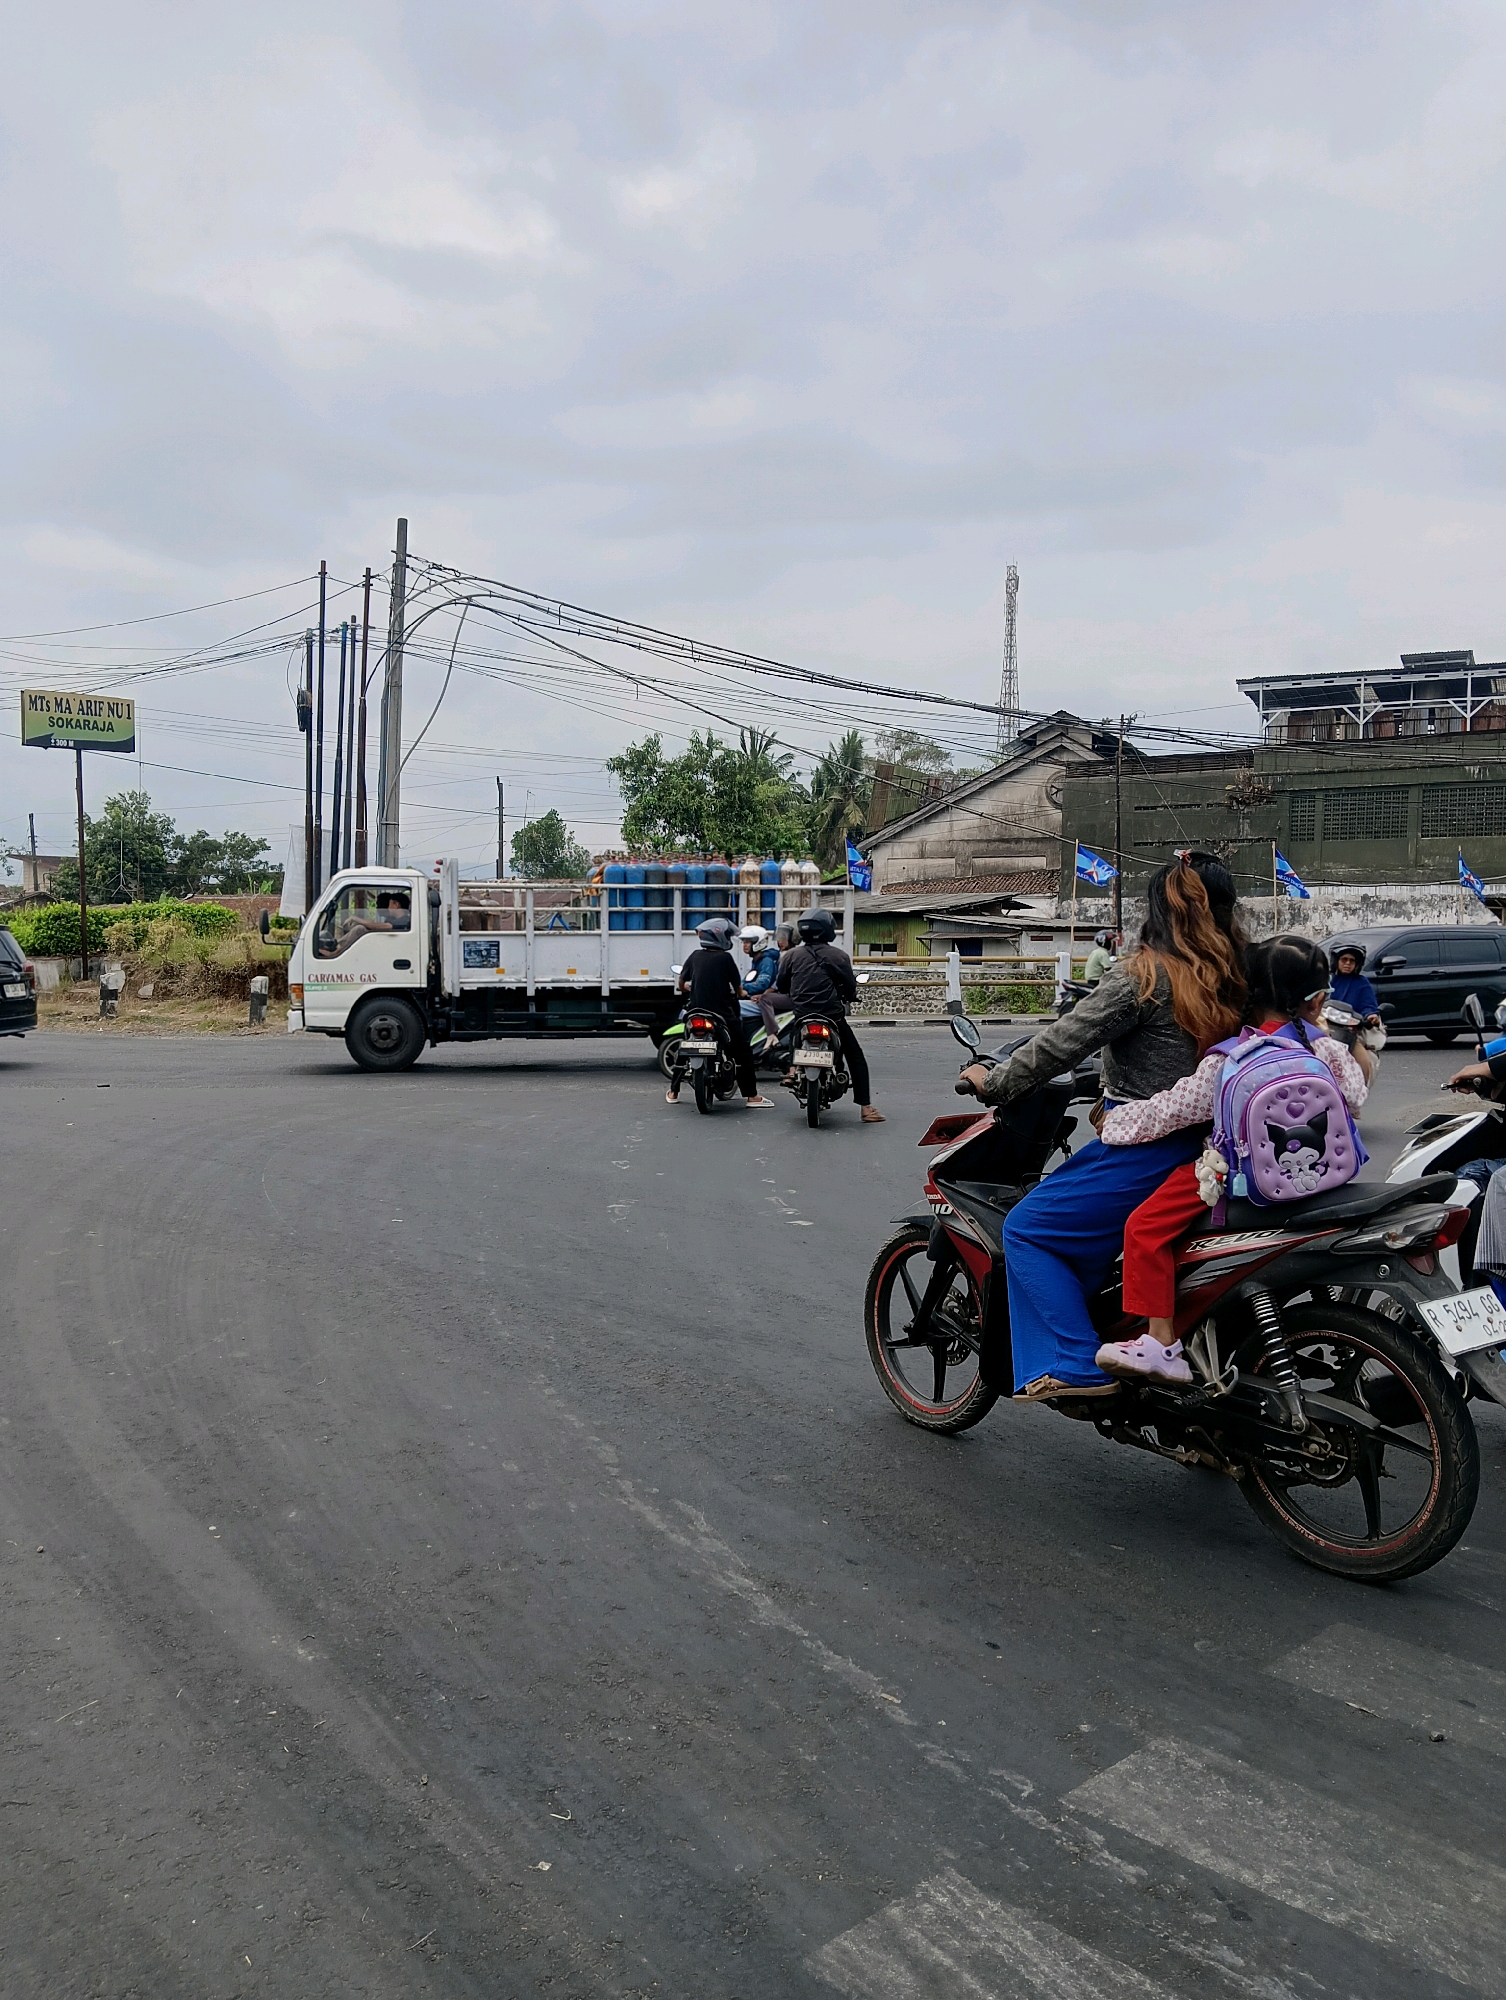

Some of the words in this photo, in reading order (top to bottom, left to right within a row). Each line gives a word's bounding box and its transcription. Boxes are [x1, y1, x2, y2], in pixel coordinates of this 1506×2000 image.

[28, 694, 51, 713] MTs
[107, 702, 124, 719] NU
[126, 703, 132, 720] 1
[48, 716, 115, 732] SOKARAJA
[308, 974, 354, 983] CARYAMAS
[360, 974, 377, 983] GAS
[1185, 1229, 1284, 1253] REVO
[1426, 1308, 1445, 1328] R
[1442, 1299, 1480, 1324] 5494
